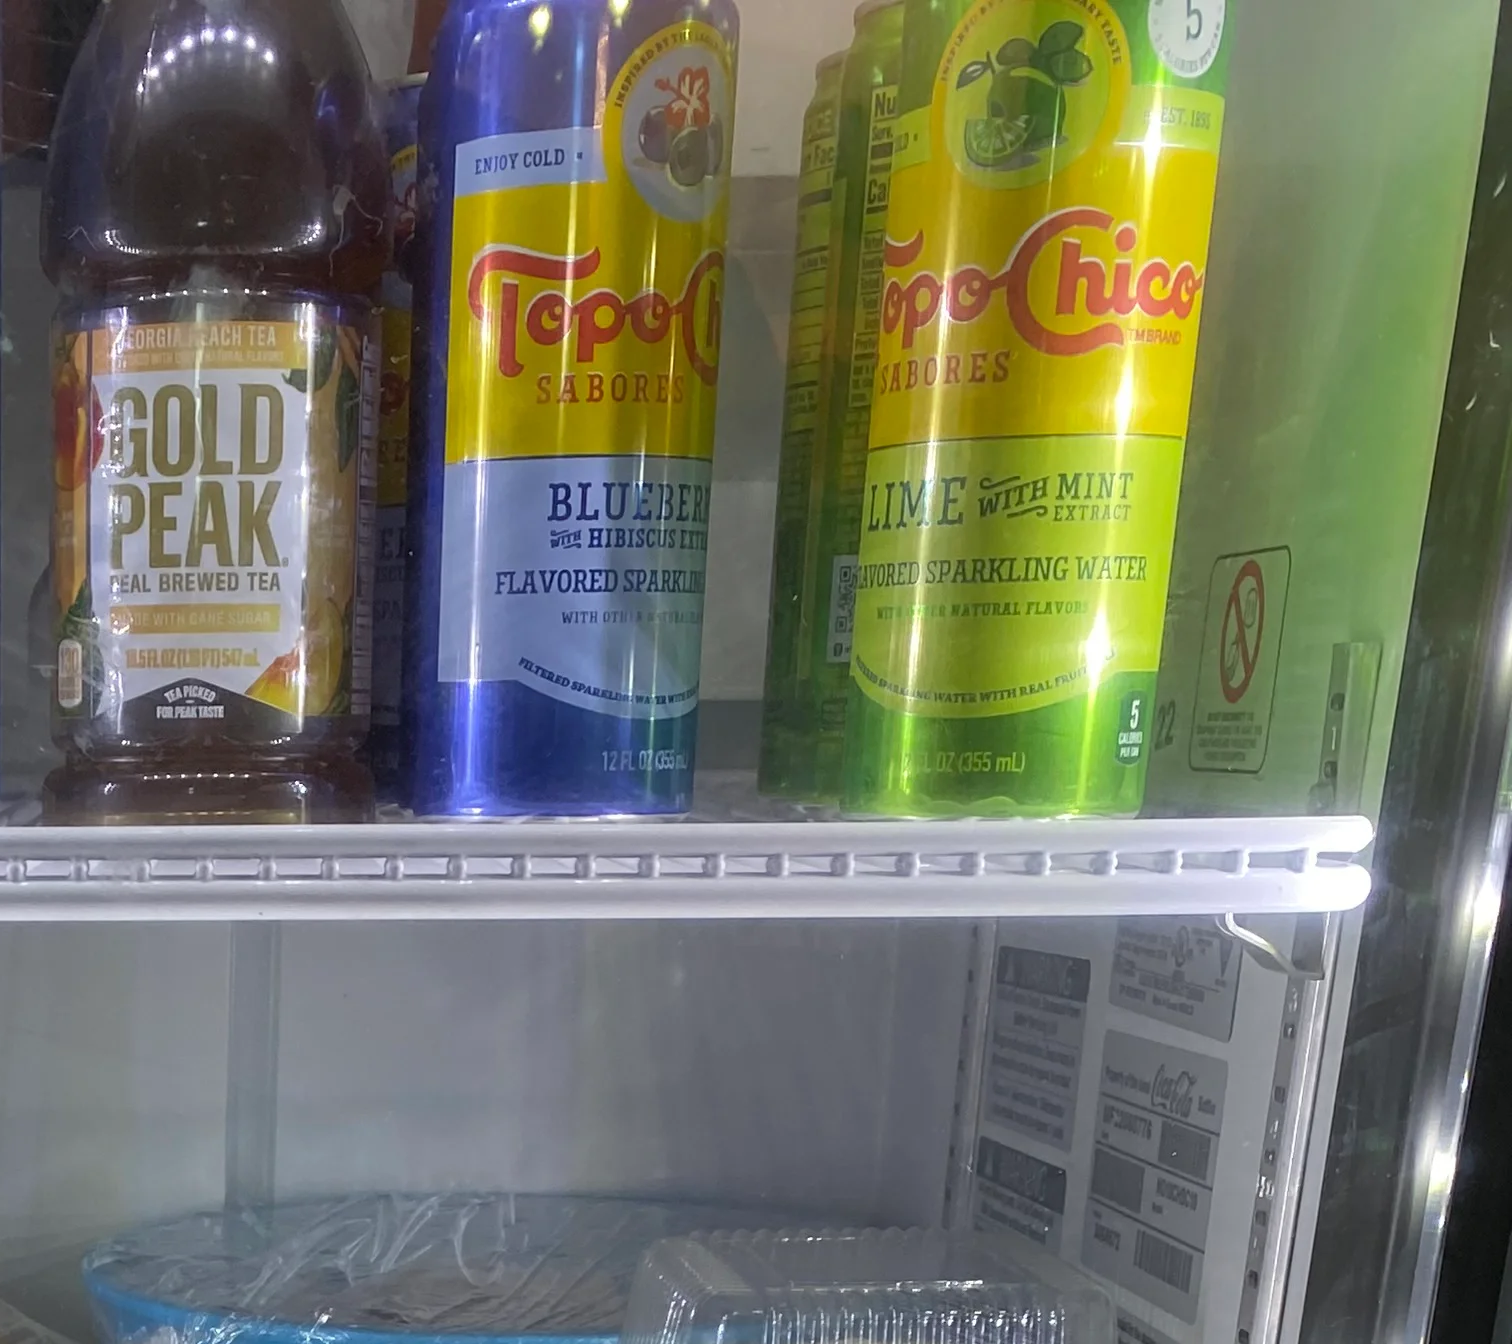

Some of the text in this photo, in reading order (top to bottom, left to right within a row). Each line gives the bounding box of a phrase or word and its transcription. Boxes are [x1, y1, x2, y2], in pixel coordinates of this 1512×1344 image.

[1100, 19, 1123, 64] TASTE
[614, 49, 655, 109] INSPIRED
[654, 36, 670, 53] BY
[1160, 110, 1187, 127] EST.
[475, 148, 565, 175] ENJOY COLD
[1005, 206, 1204, 357] Chico
[468, 244, 672, 378] Topo
[121, 327, 181, 351] EORGIA
[249, 325, 277, 346] TEA
[1147, 330, 1181, 345] BRAND
[879, 351, 1011, 396] SABORES
[536, 374, 684, 404] SABORES
[109, 383, 284, 478] GOLD
[867, 472, 1134, 532] LIME WITH MINT
[1053, 504, 1132, 522] EXTRACT
[109, 480, 284, 569] PEAK
[550, 528, 676, 550] WITH HIBISCUS
[159, 572, 238, 593] BREWED
[247, 572, 280, 592] TEA
[494, 569, 619, 595] FLAVORED
[924, 556, 1068, 585] SPARKLING
[1076, 555, 1147, 582] WATER
[152, 610, 185, 627] WITH
[228, 610, 271, 625] SUGAR
[562, 611, 598, 625] WITH
[951, 601, 1021, 618] NATURAL
[1026, 599, 1088, 616] FLAVORS
[518, 657, 570, 688] FILTERED
[934, 691, 978, 704] WATER
[980, 688, 1018, 702] WITH
[1019, 680, 1053, 699] REAL
[1054, 665, 1088, 688] FRUIT
[164, 685, 216, 703] TEA PICKED
[156, 705, 224, 719] FOR PEAK TASTE
[1130, 700, 1141, 729] 5
[602, 751, 617, 771] 12
[620, 751, 635, 771] FL
[639, 750, 652, 771] OZ
[958, 751, 992, 775] (355
[995, 751, 1026, 774] mL)
